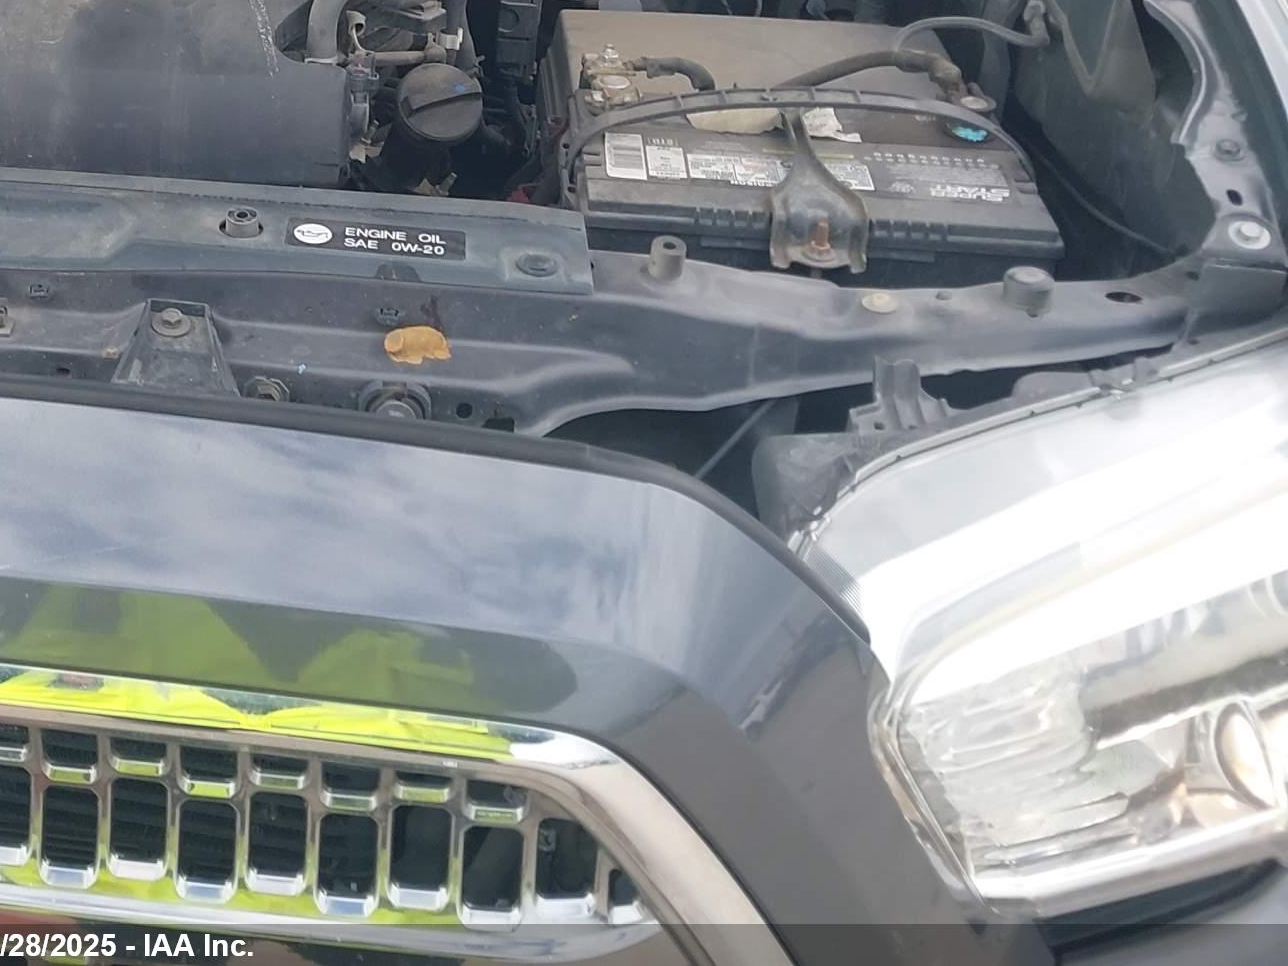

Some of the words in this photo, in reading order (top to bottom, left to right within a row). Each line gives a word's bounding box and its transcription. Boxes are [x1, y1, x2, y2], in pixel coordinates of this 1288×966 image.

[345, 227, 407, 241] ENGINE
[418, 233, 446, 244] OIL
[344, 237, 379, 249] SAE
[391, 242, 445, 255] 0W-20
